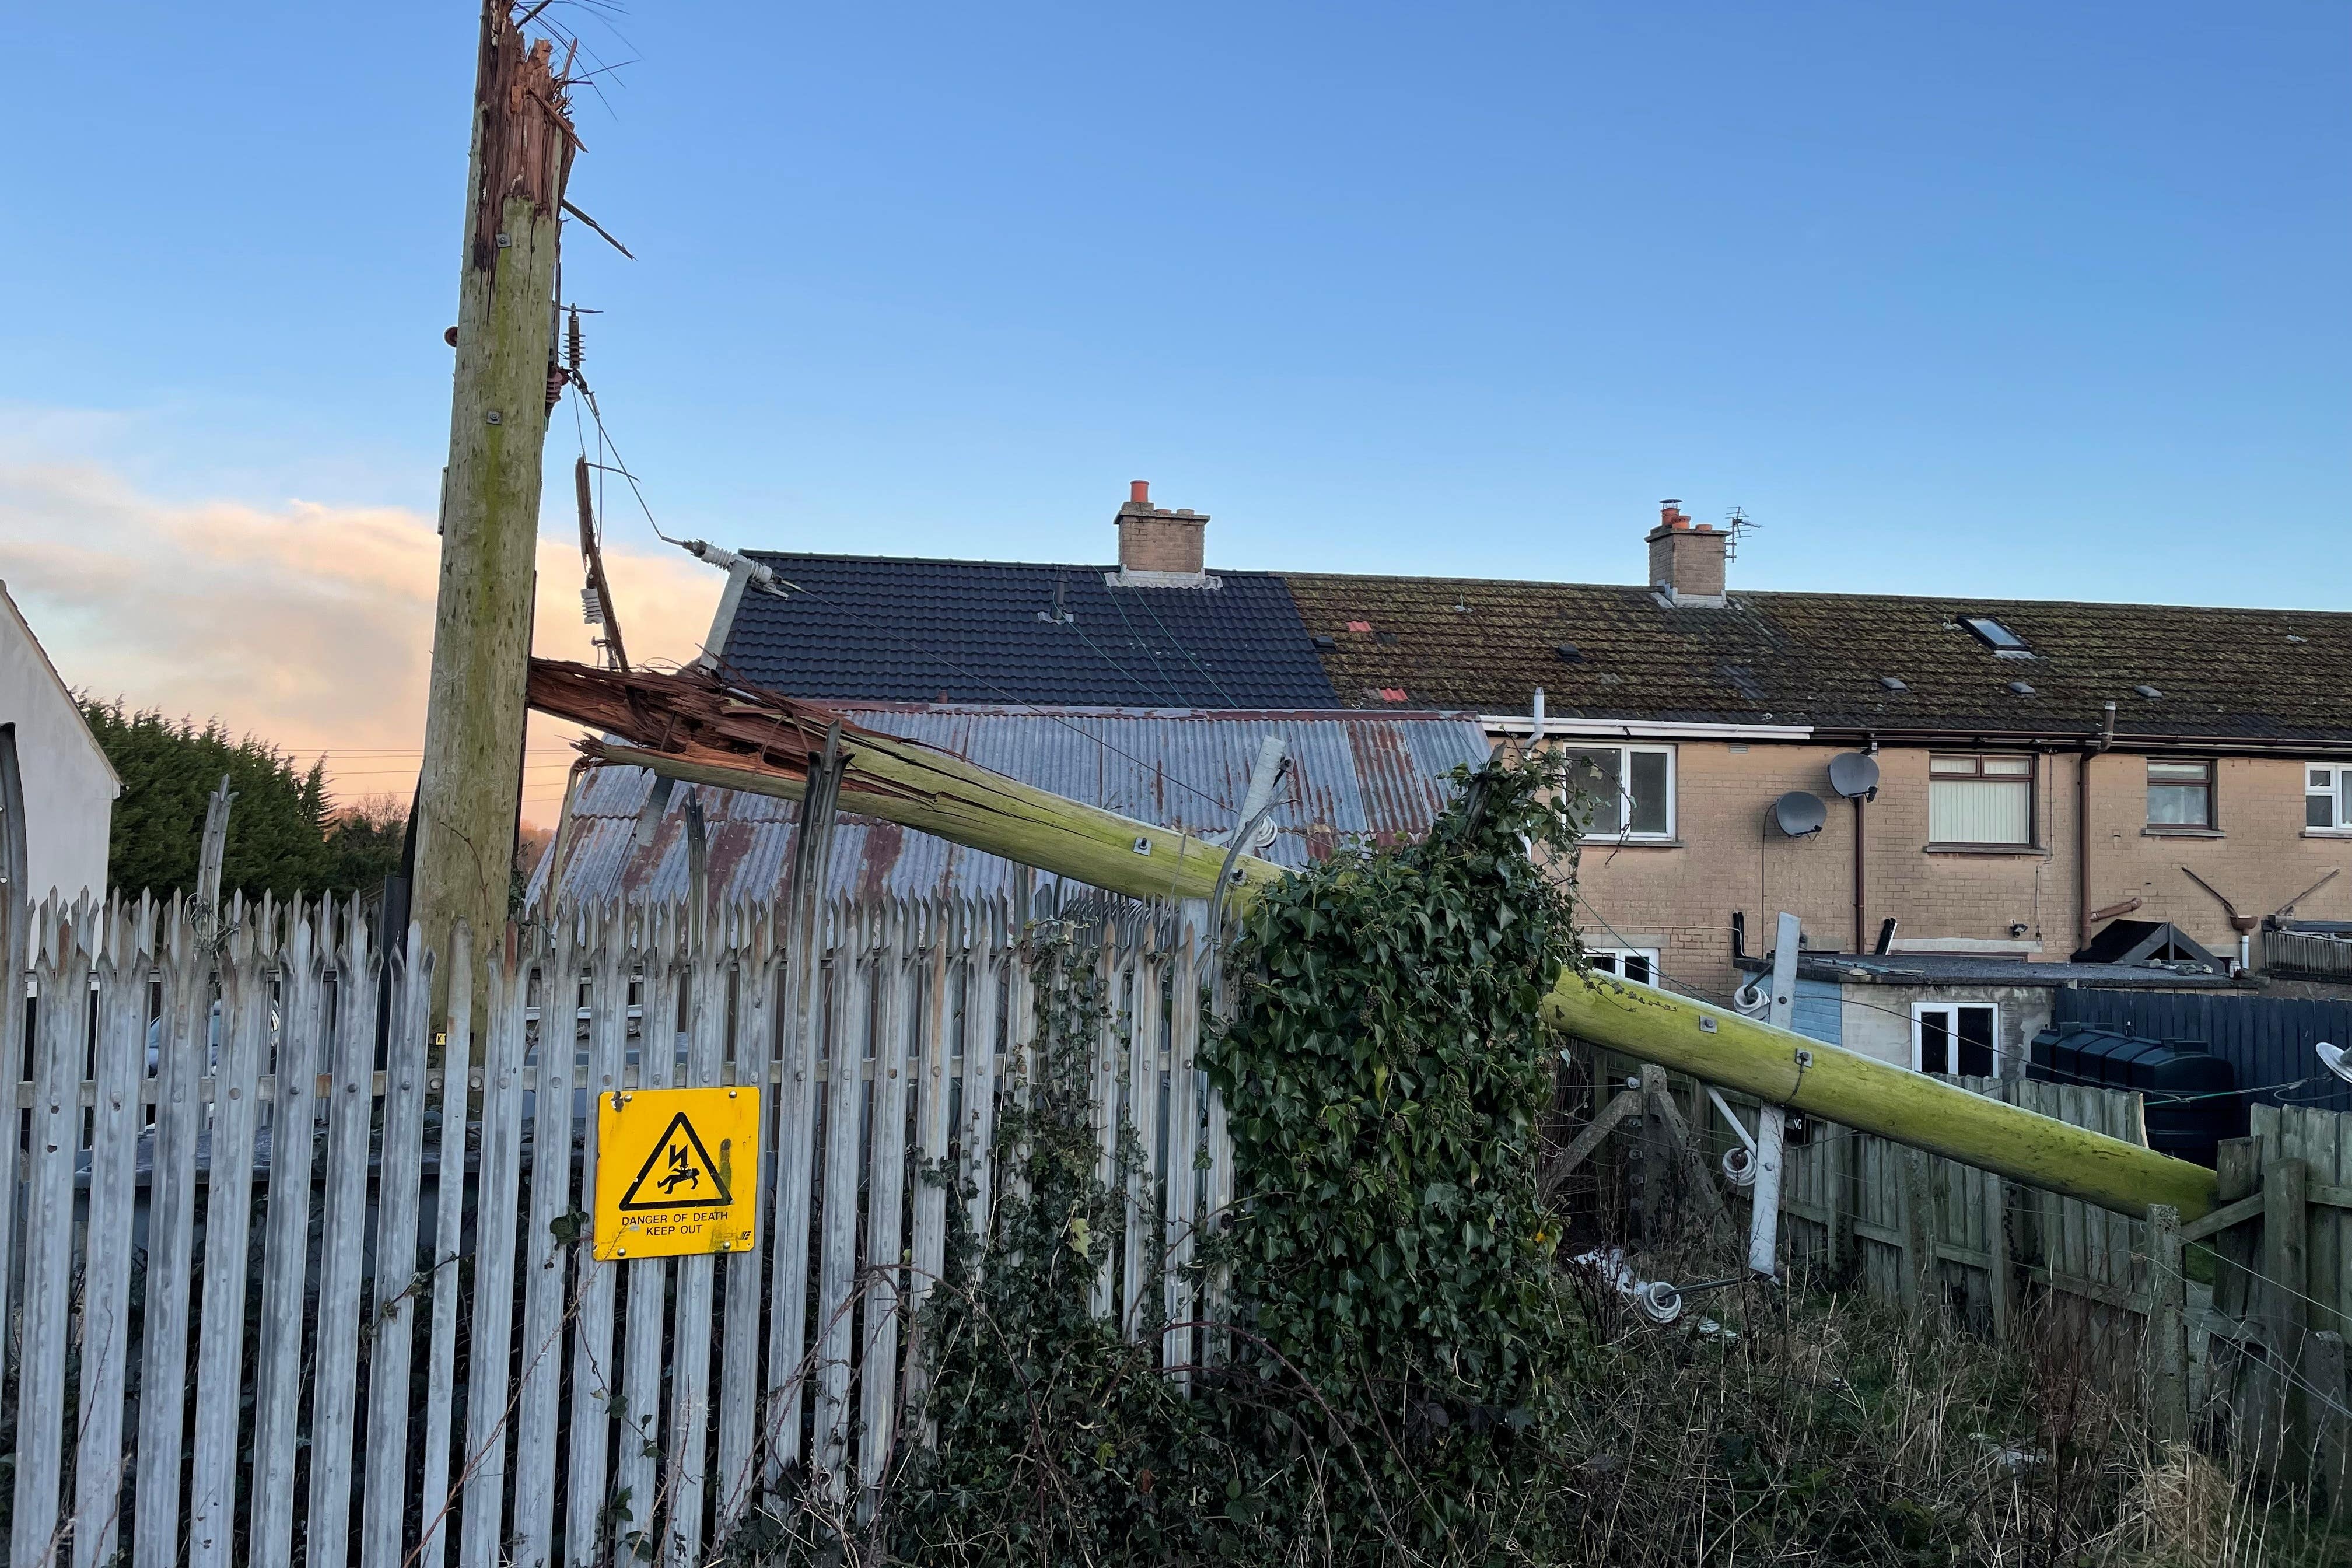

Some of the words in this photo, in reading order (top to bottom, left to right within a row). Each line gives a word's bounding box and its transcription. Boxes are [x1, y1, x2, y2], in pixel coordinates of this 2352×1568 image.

[437, 1035, 442, 1043] K
[621, 1215, 667, 1226] DANGER
[674, 1214, 688, 1223] OF
[694, 1212, 728, 1222] DEATH
[646, 1226, 676, 1236] KEEP
[680, 1225, 703, 1234] OUT
